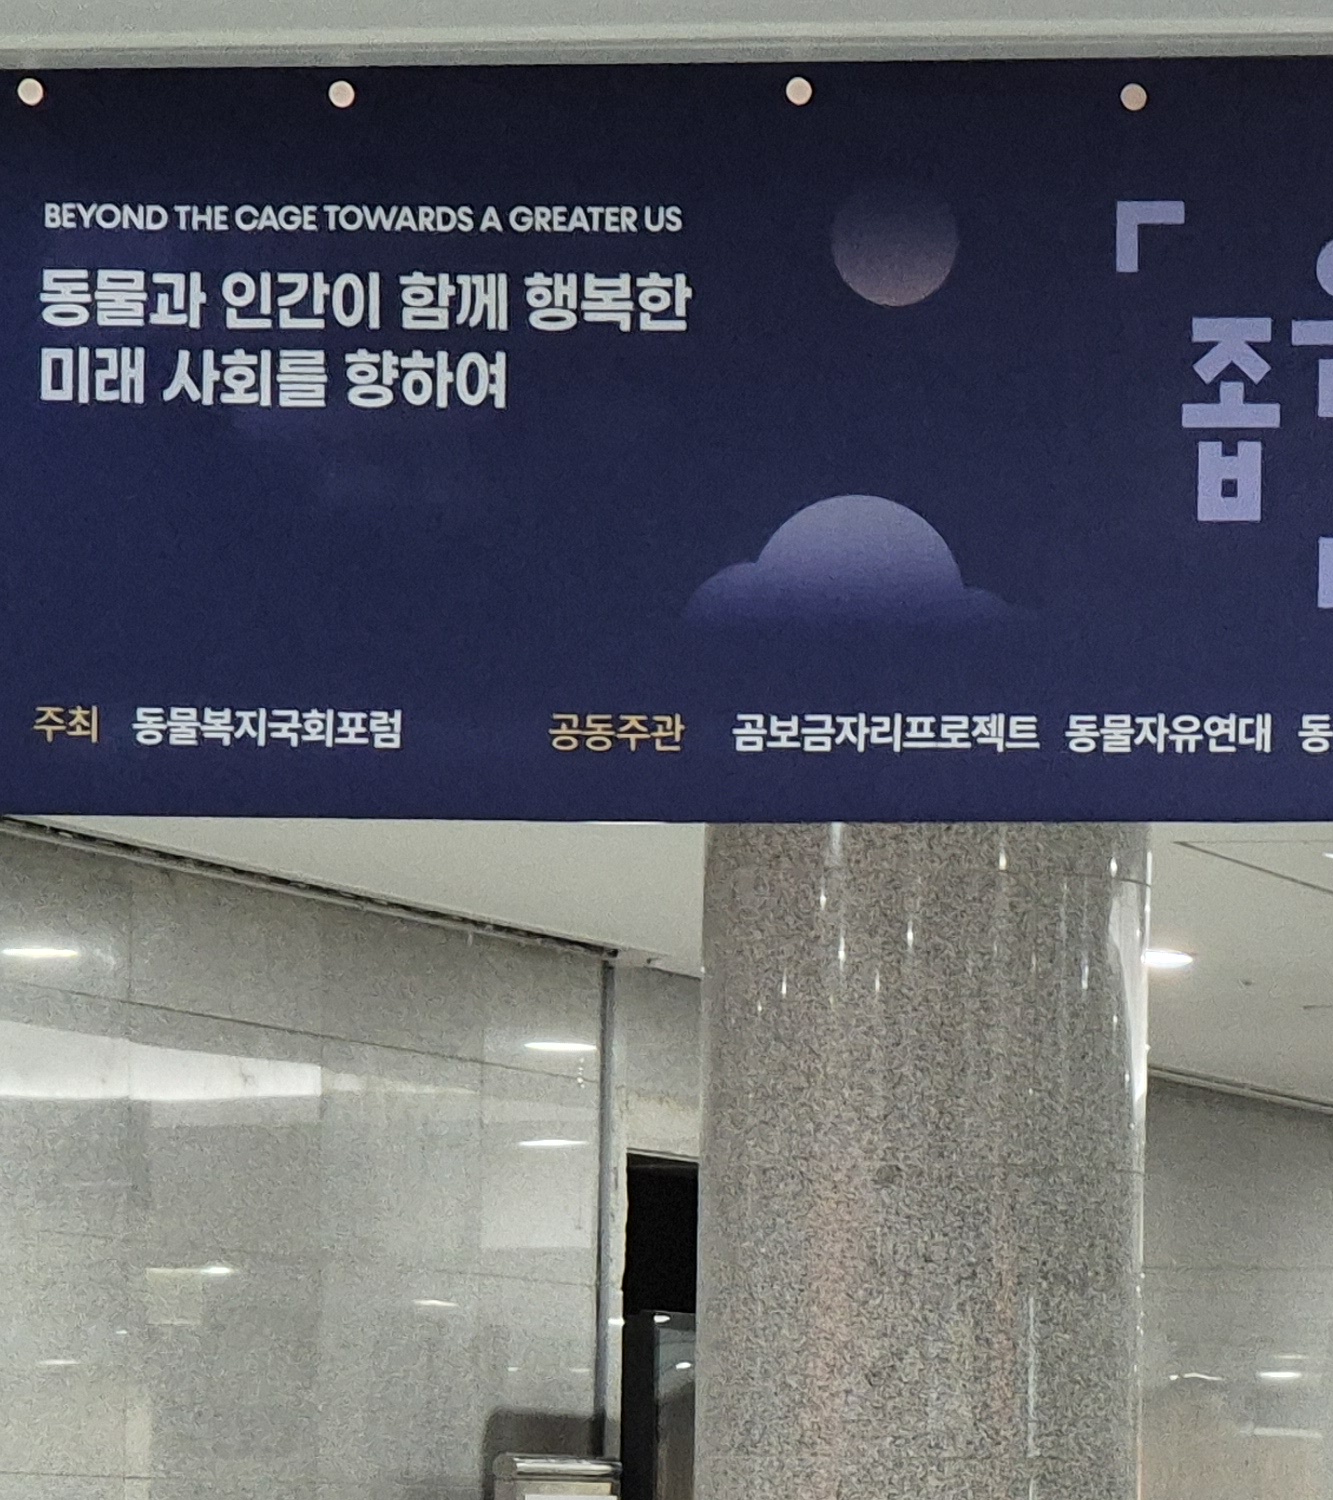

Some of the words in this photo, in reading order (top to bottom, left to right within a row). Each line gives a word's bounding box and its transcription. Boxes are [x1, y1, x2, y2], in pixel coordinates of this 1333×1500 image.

[44, 202, 168, 231] BEYOND
[174, 205, 230, 231] THE
[235, 205, 318, 232] CAGE
[323, 205, 474, 233] TOWARDS
[480, 206, 503, 232] A
[509, 206, 638, 233] GREATER
[644, 206, 683, 232] US
[39, 268, 207, 329] 동물과
[221, 271, 380, 330] 인간이
[399, 271, 508, 331] 함께
[524, 272, 693, 332] 행복한
[40, 346, 145, 405] 미래
[162, 348, 328, 408] 사회를
[344, 348, 506, 409] 향하여
[33, 705, 99, 743] 주최
[132, 706, 402, 749] 동물복지국회포럼
[548, 713, 685, 751] 공동주관
[732, 712, 1041, 753] 곰보금자리프로젝트
[1065, 712, 1272, 754] 동물자유연대
